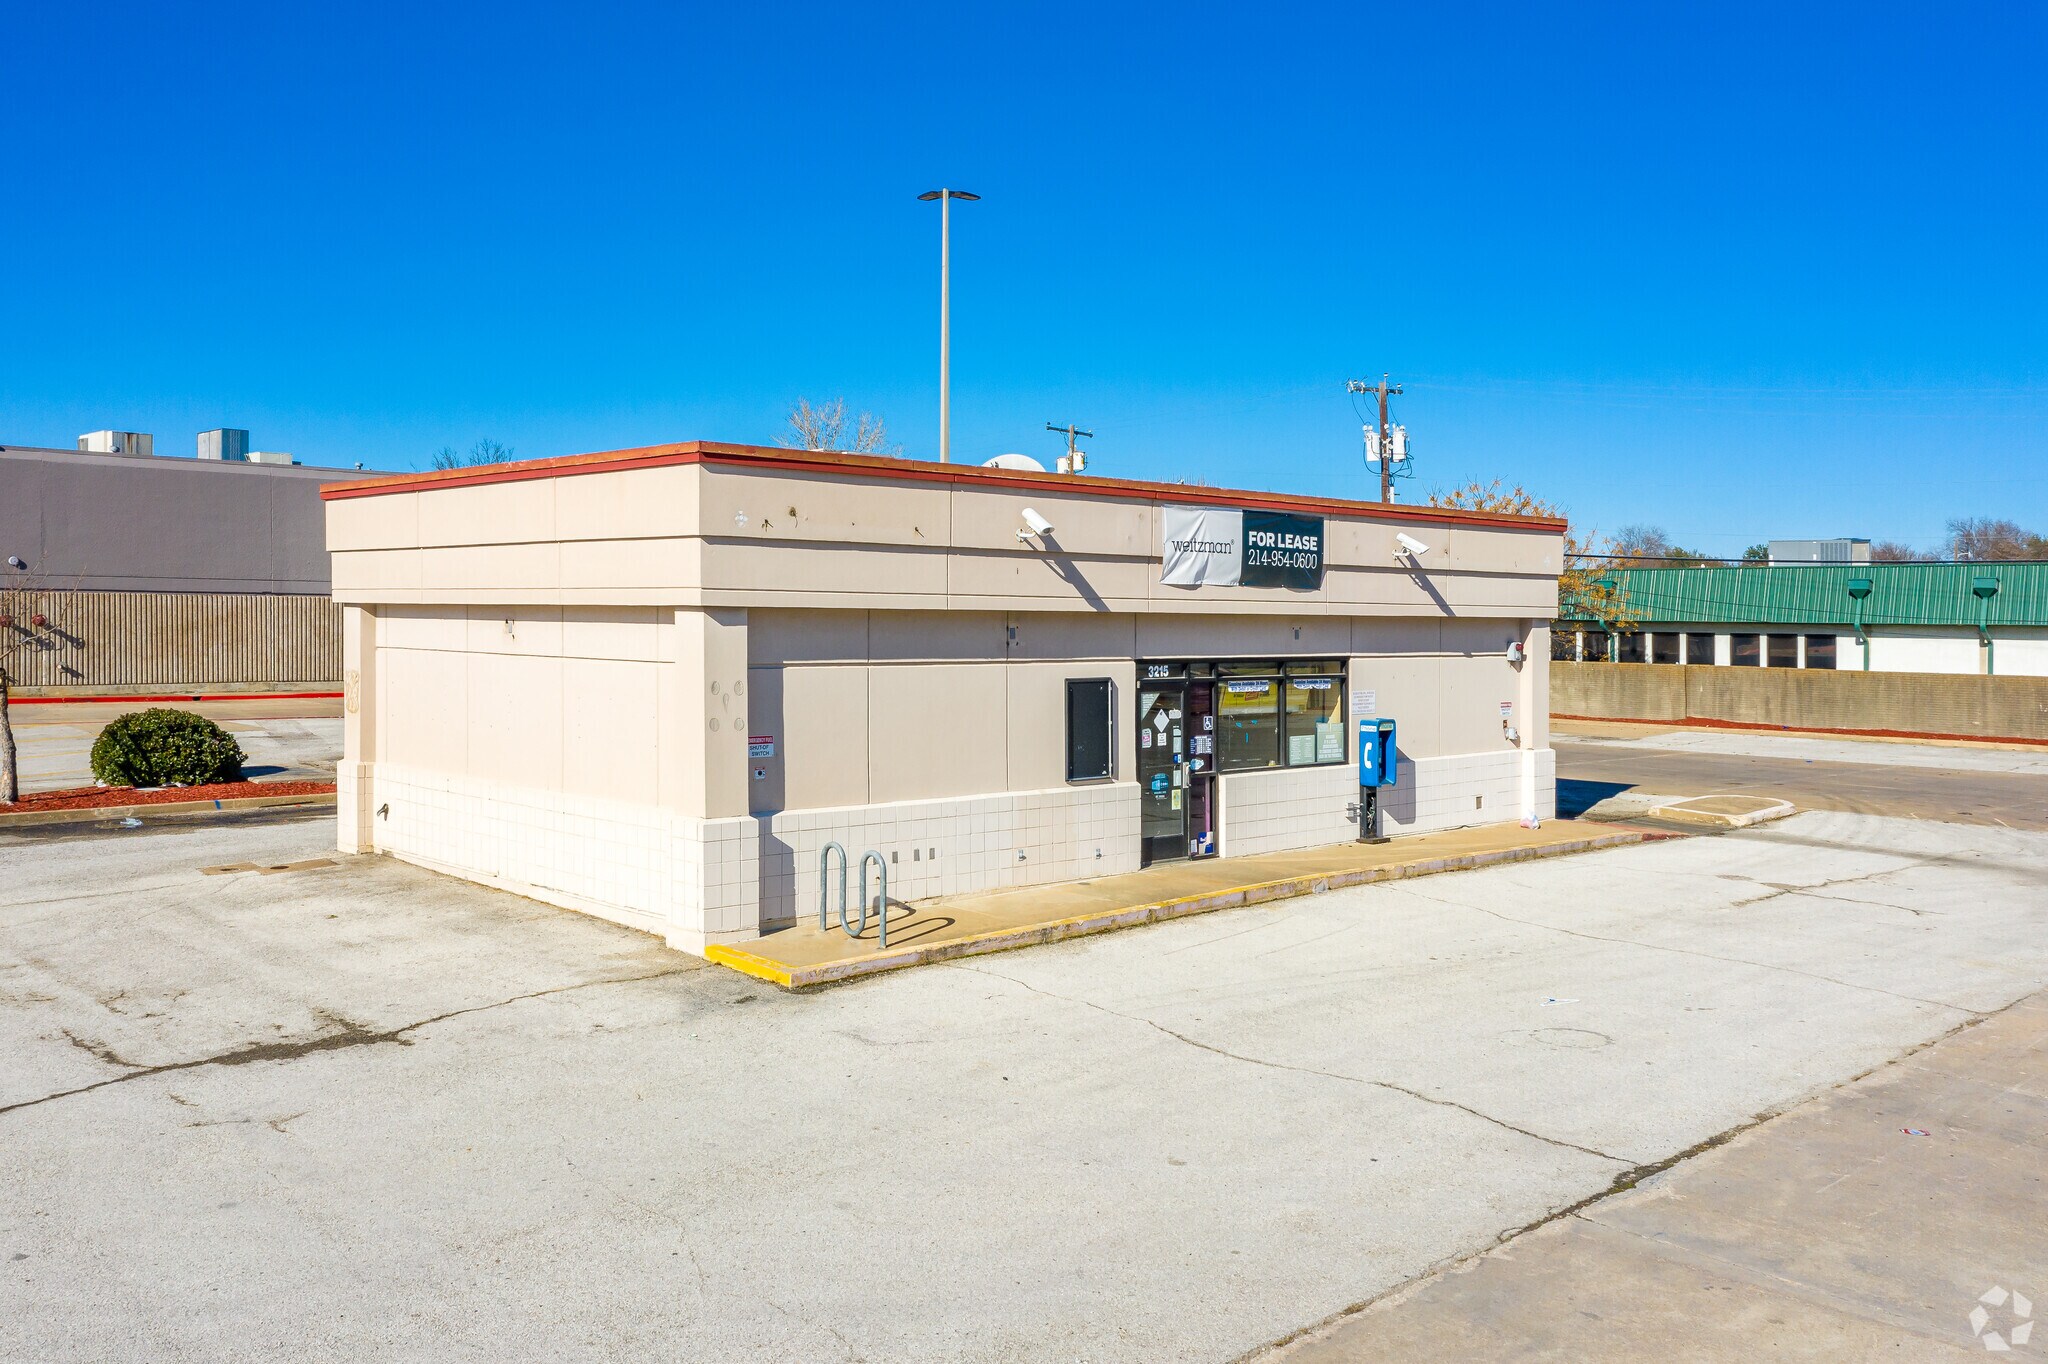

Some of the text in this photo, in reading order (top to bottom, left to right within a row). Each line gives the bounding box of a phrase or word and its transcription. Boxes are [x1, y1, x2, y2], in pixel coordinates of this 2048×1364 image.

[1249, 531, 1318, 551] FOR LEASE
[1248, 549, 1318, 570] 214-954-0600
[1148, 665, 1169, 678] 3215
